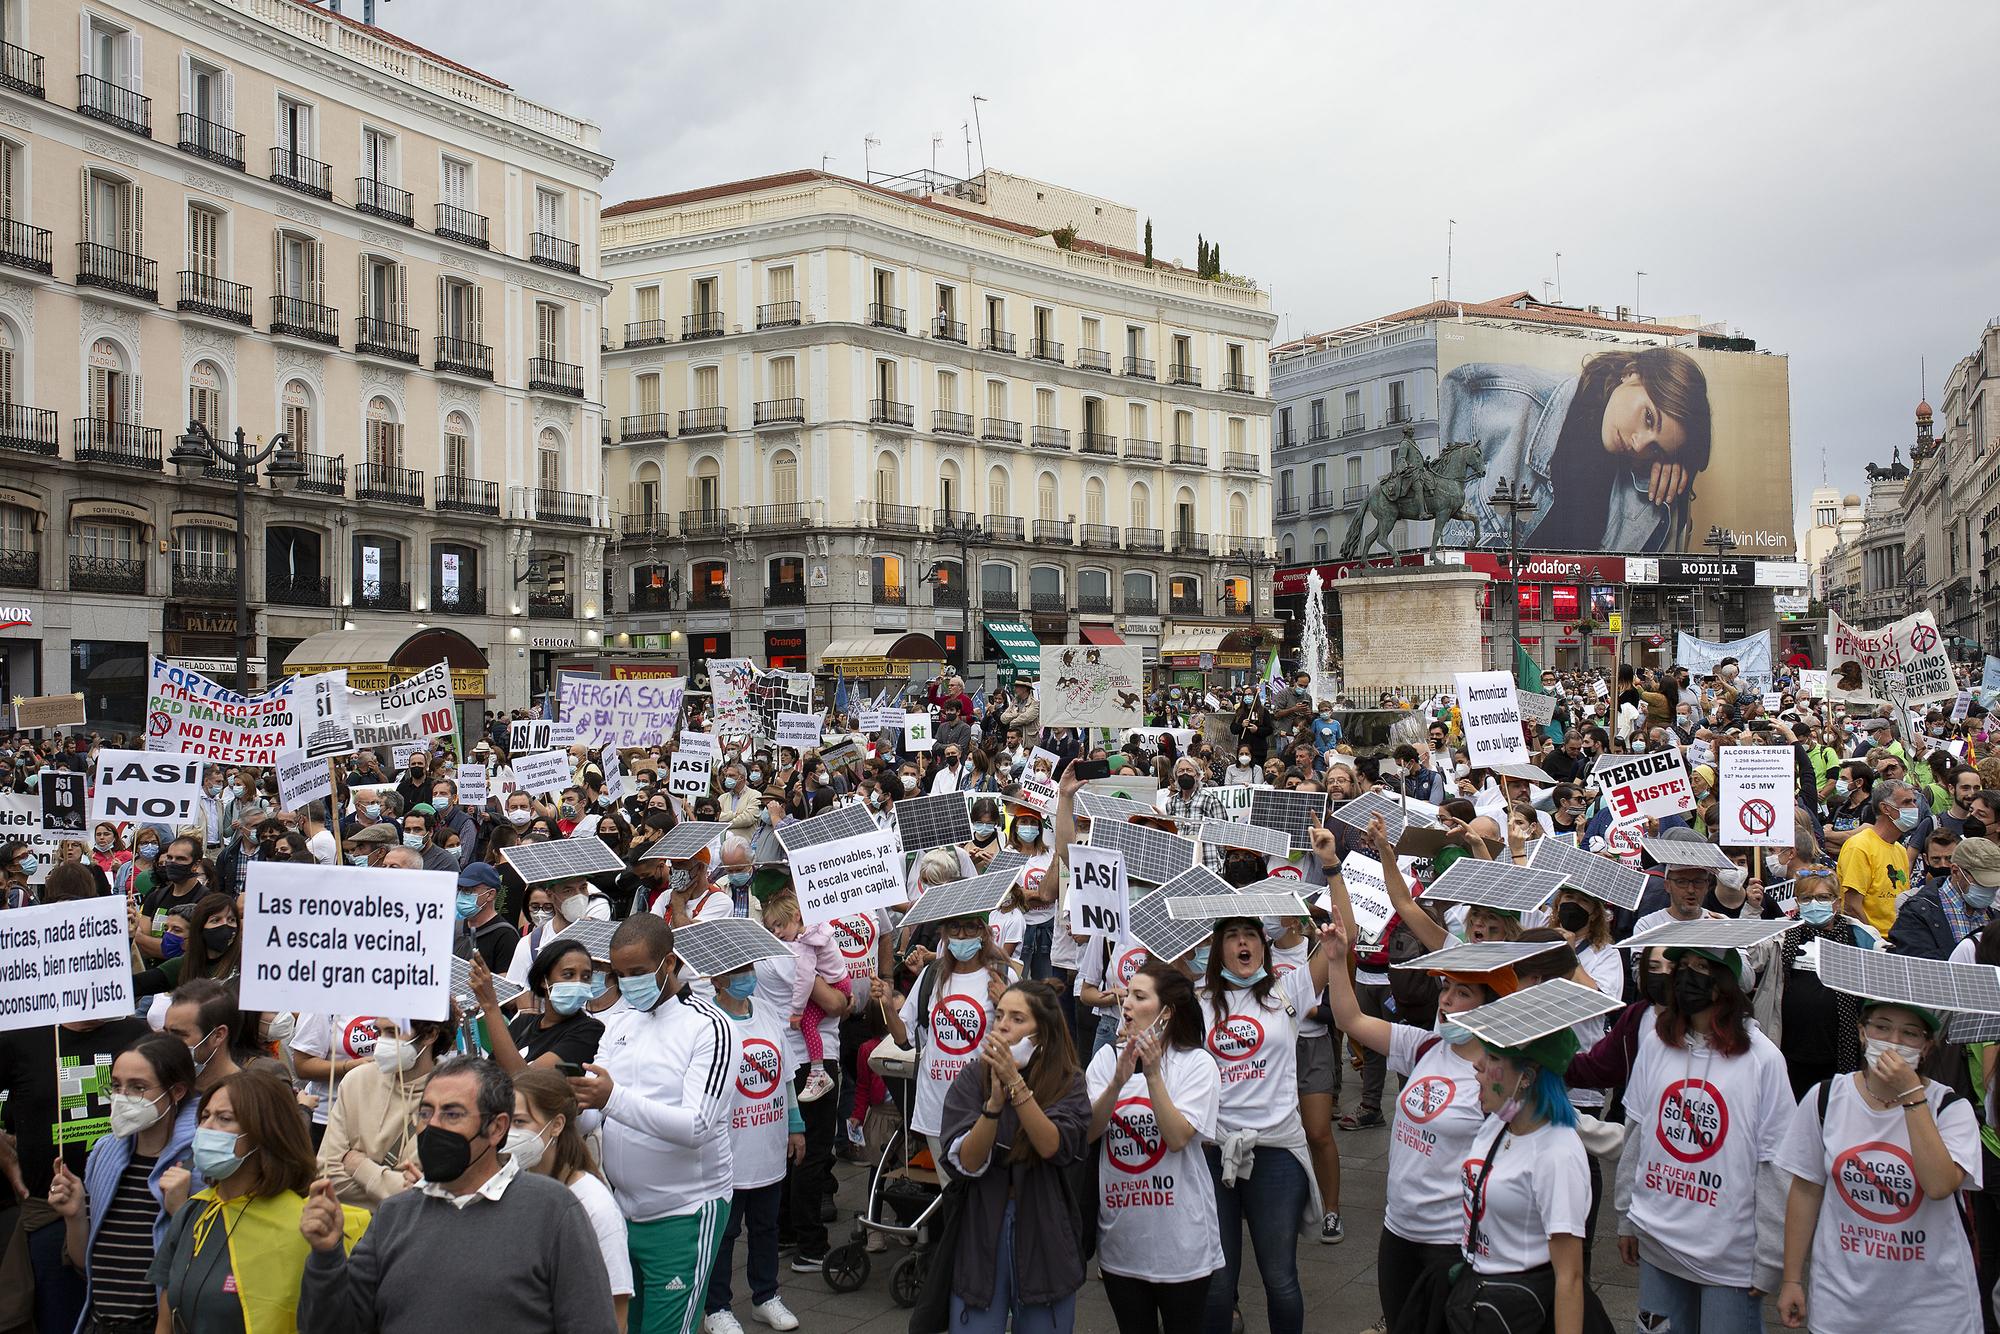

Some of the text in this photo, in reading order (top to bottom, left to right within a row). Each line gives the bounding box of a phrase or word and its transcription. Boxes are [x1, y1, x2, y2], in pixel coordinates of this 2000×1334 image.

[1755, 530, 1787, 547] Klein
[1681, 563, 1738, 575] RODILLA
[988, 623, 1027, 633] CHANGE
[532, 637, 575, 648] SEPHORA
[770, 637, 801, 647] Orange
[1000, 640, 1038, 648] TRANSFER
[1880, 642, 1902, 667] ASÍ
[1899, 654, 1945, 675] MOLINOS
[178, 661, 215, 671] HELADOS
[354, 678, 386, 689] TICKETS
[1468, 684, 1508, 702] Armonizar
[380, 685, 448, 710] EÓLICAS
[560, 682, 632, 710] ENERGÍA
[150, 696, 293, 729] RED NATURA 2000
[356, 715, 372, 726] EN
[421, 708, 453, 736] NO
[1467, 707, 1520, 727] las renovables
[779, 717, 795, 730] Energías
[178, 722, 286, 747] NO EN MASA
[511, 720, 550, 751] ASÍ, NO
[803, 731, 818, 741] alcance.
[1477, 733, 1522, 753] con su lugar.
[102, 761, 200, 785] ¡ASÍ
[673, 760, 710, 773] ¡ASÍ
[1599, 752, 1682, 788] TERUEL
[295, 781, 314, 797] nuestro
[673, 779, 706, 793] NO!
[1023, 780, 1055, 799] TERUEL
[1758, 782, 1775, 790] MW
[105, 797, 190, 819] NO!
[797, 843, 892, 876] Las renovables, ya:
[808, 861, 889, 891] A escala vecinal,
[1073, 861, 1118, 891] ¡ASÍ
[807, 876, 900, 909] no del gran capital.
[1768, 882, 1795, 902] TERU
[258, 892, 444, 925] Las renovables, ya:
[1360, 896, 1388, 920] alcance.
[1081, 904, 1121, 934] NO!
[0, 915, 122, 949] tricas, nada éticas.
[267, 925, 427, 957] A escala vecinal,
[43, 947, 124, 977] bien rentables.
[258, 959, 439, 990] no del gran capital.
[62, 980, 126, 1011] muy justo.
[936, 1016, 979, 1029] SOLARES
[937, 1008, 976, 1020] PLACAS
[938, 1028, 976, 1042] ASÍ NO
[1219, 1037, 1256, 1051] ASÍ NO
[931, 1059, 968, 1069] LA FUEVA
[1251, 1059, 1267, 1070] NO
[742, 1067, 778, 1088] ASÍ NO
[733, 1095, 785, 1117] LA FUEVA NO
[1406, 1096, 1436, 1115] ASÍ NO
[1667, 1095, 1716, 1116] PLACAS
[732, 1108, 784, 1129] SE VENDE
[1109, 1113, 1154, 1129] PLACAS
[1663, 1106, 1719, 1130] SOLARES
[1109, 1125, 1159, 1140] SOLARES
[1422, 1129, 1437, 1144] NO
[1665, 1124, 1714, 1149] ASÍ NO
[1113, 1138, 1159, 1158] ASÍ NO
[1403, 1136, 1434, 1158] VENDE
[1647, 1160, 1723, 1190] LA FUEVA NO
[1846, 1158, 1906, 1176] PLACAS
[1105, 1175, 1175, 1194] LA NO
[1645, 1173, 1718, 1207] SE VENDE
[1843, 1170, 1913, 1190] SOLARES
[1850, 1186, 1911, 1209] ASÍ NO
[1840, 1222, 1927, 1245] LA FUEVA NO
[1840, 1235, 1926, 1263] SE VENDE
